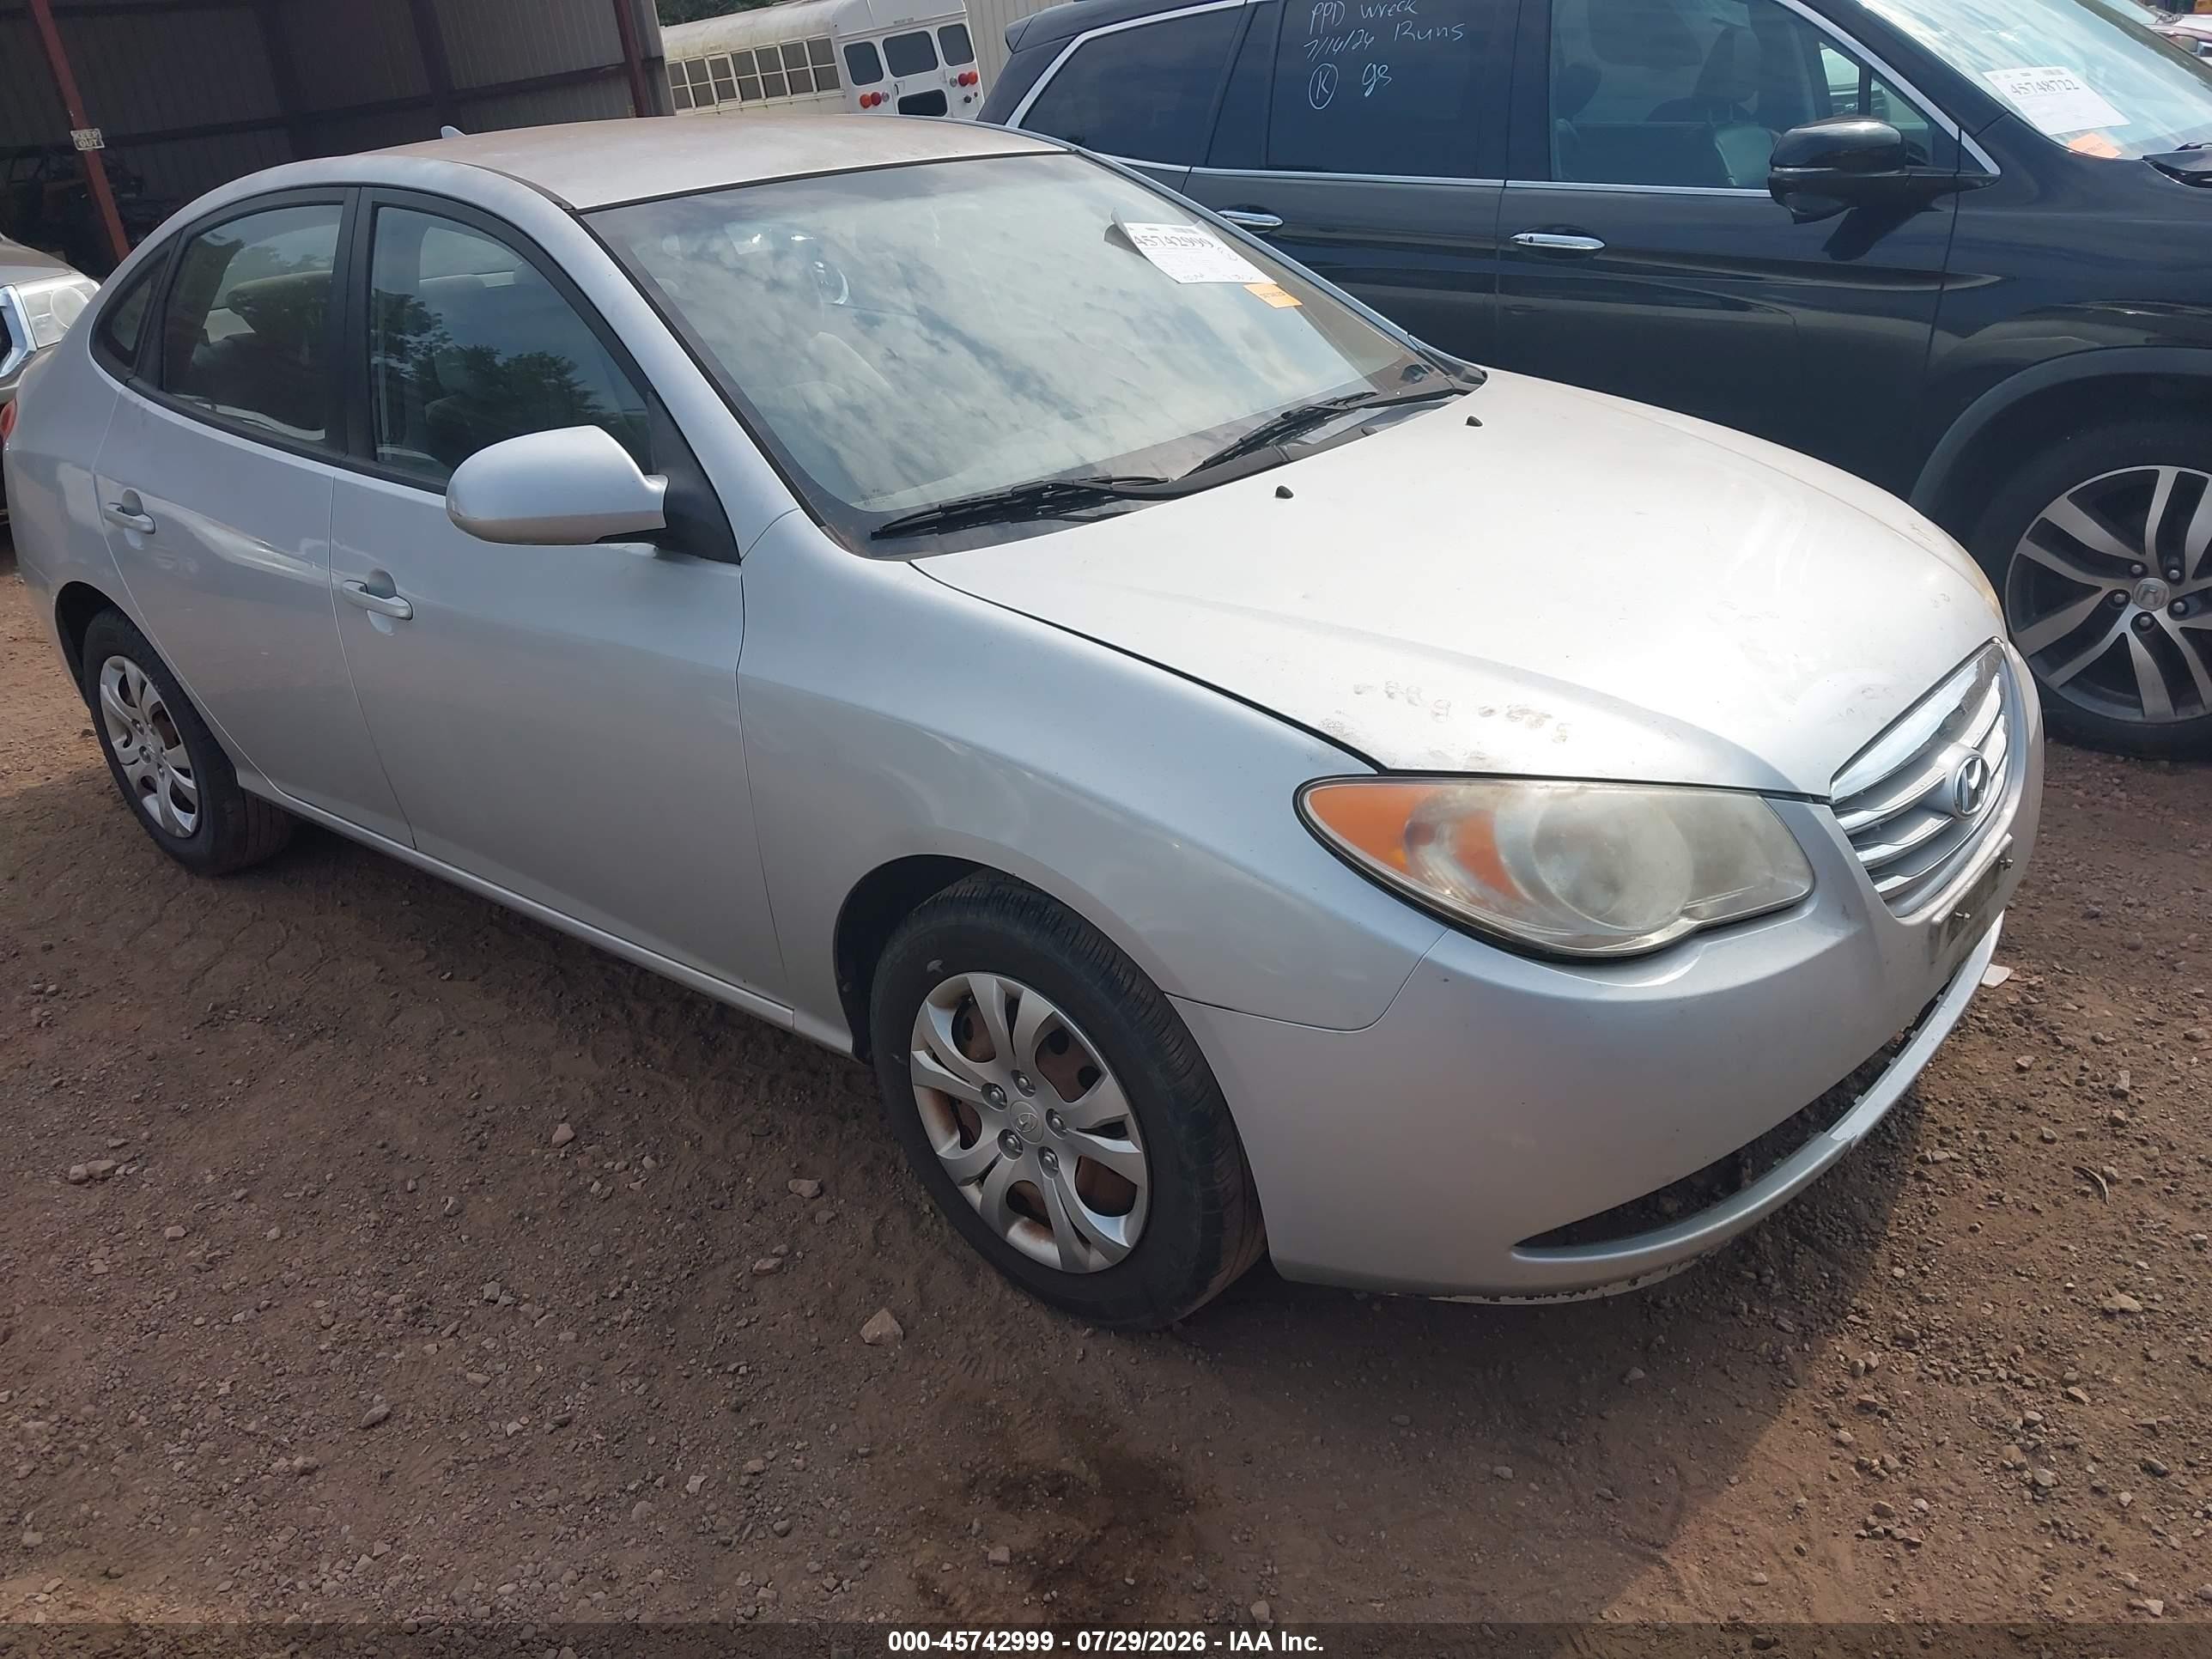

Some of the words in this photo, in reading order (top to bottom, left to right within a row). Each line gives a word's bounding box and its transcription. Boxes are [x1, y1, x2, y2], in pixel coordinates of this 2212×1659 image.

[1310, 0, 1346, 35] PPD
[1359, 0, 1419, 20] wreck
[1394, 20, 1466, 42] Runs
[2010, 79, 2080, 95] 45748722
[1133, 234, 1215, 249] 45742999
